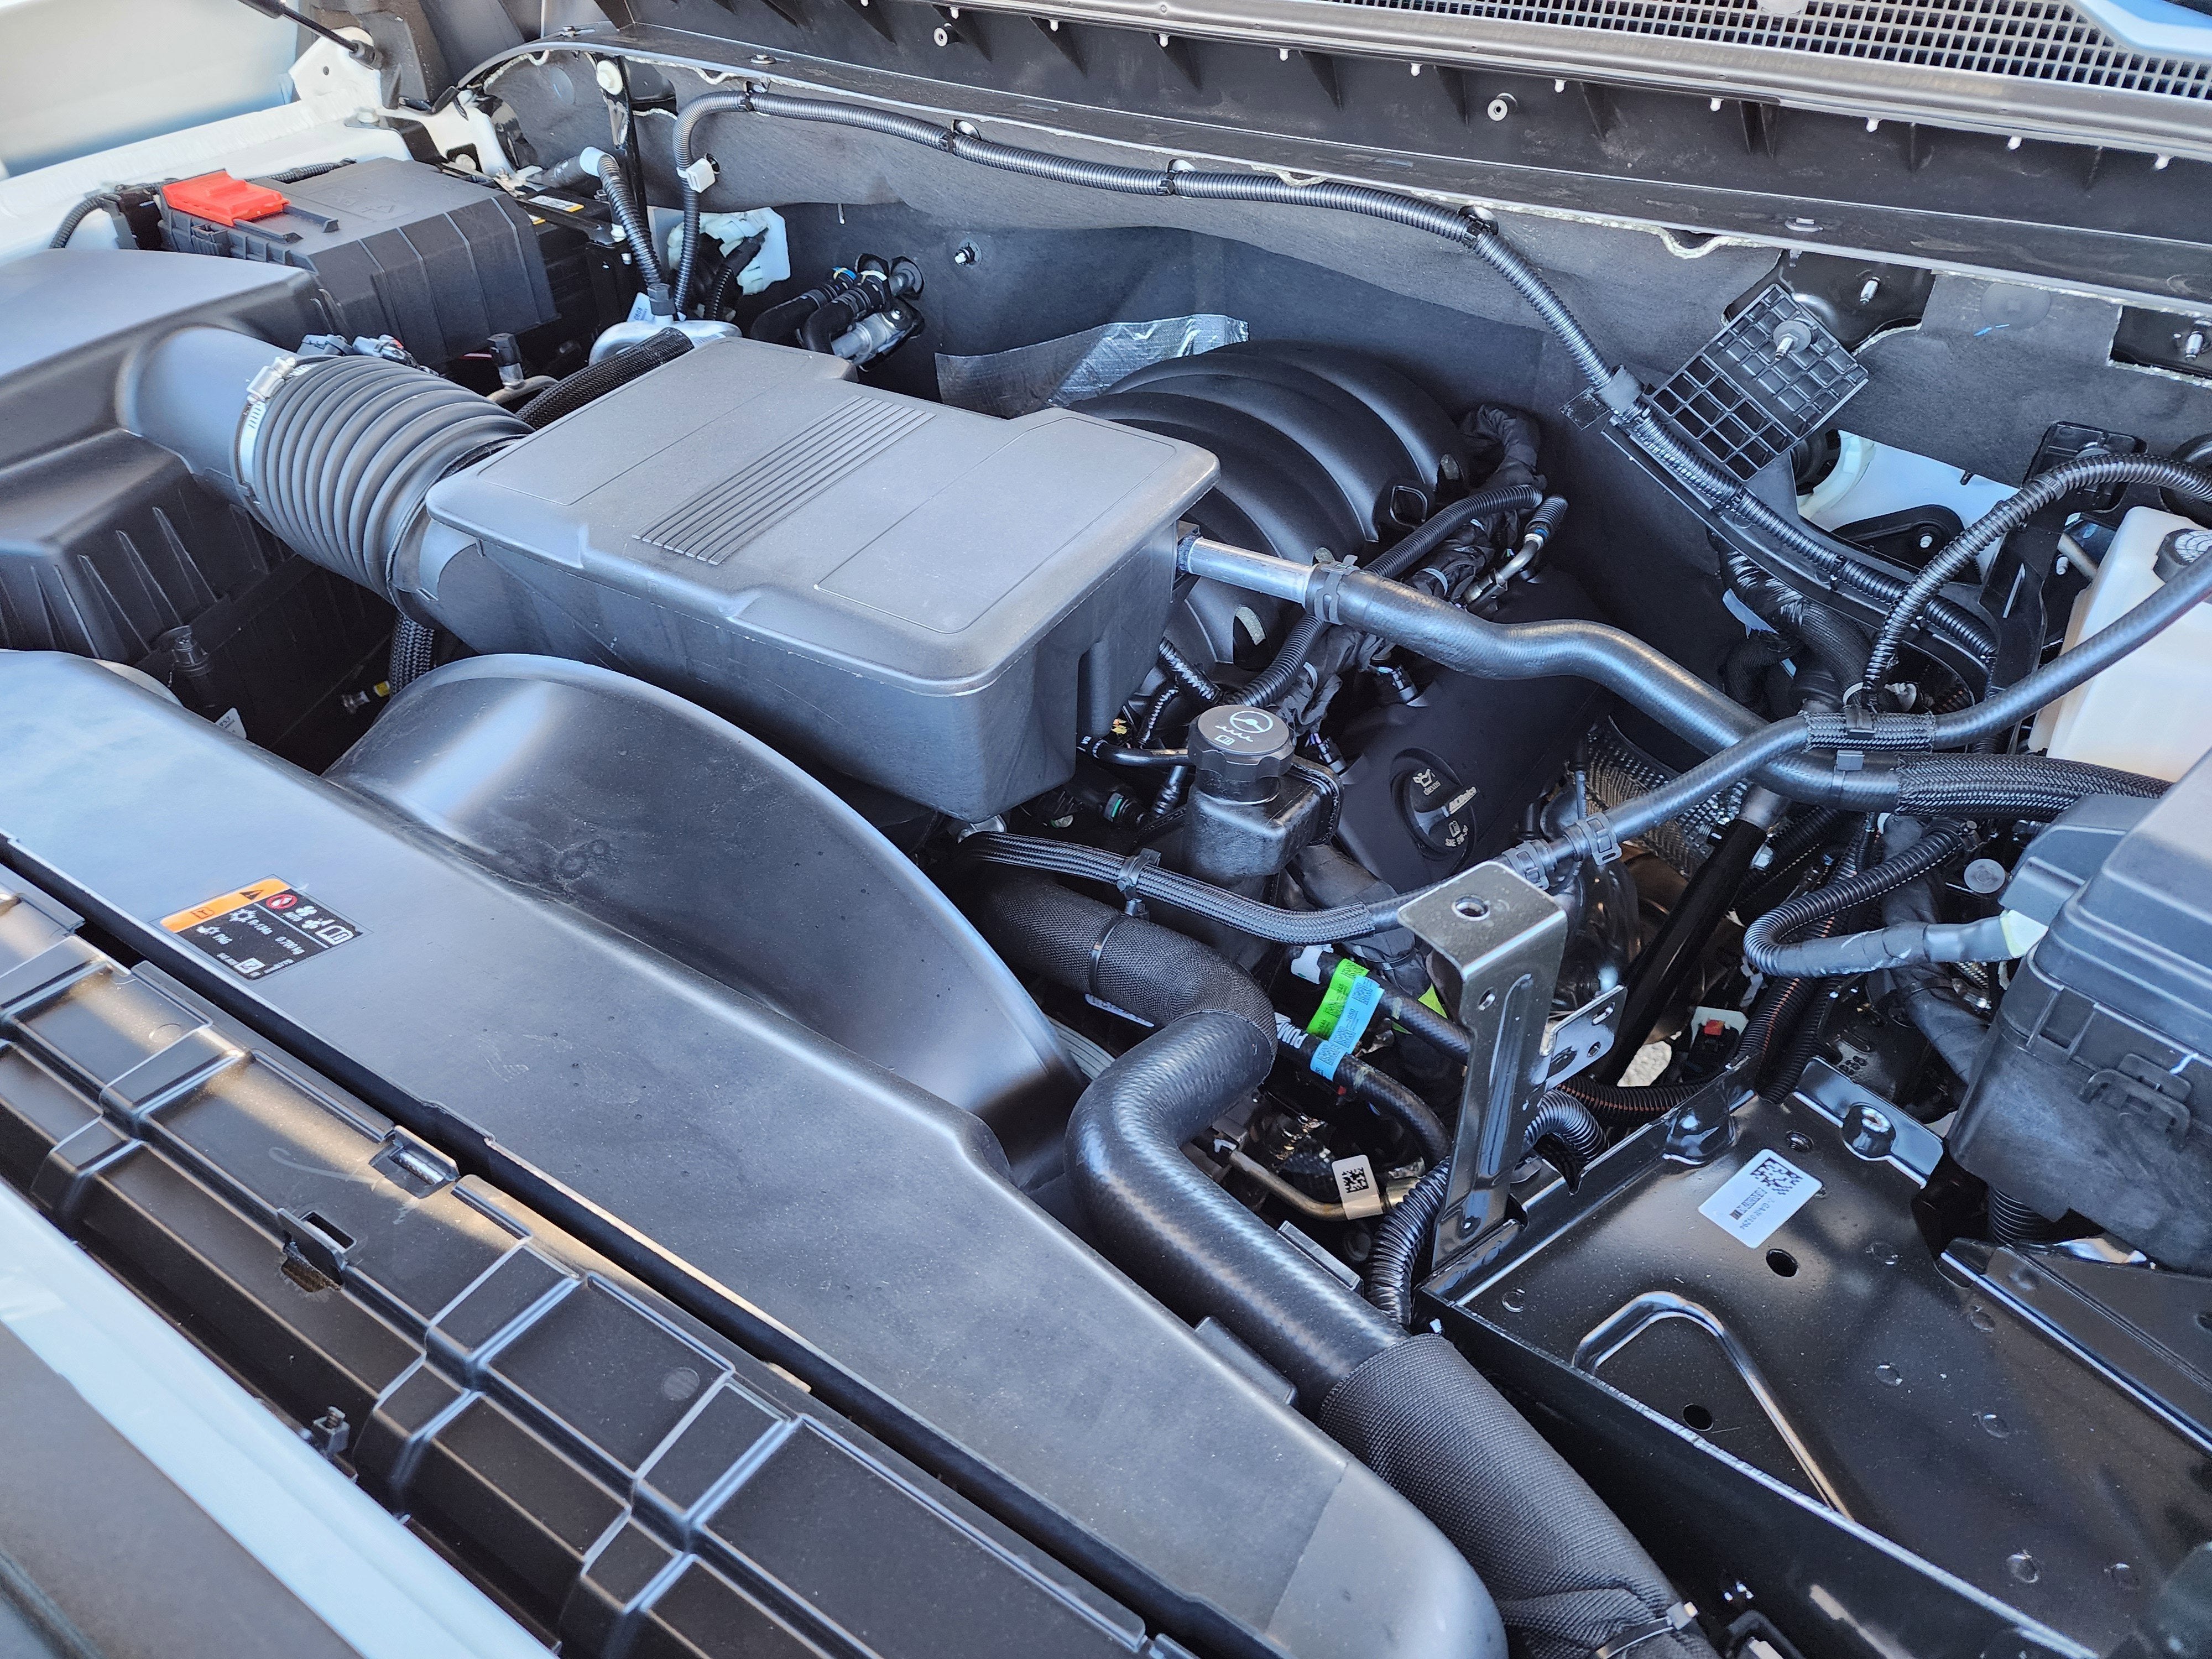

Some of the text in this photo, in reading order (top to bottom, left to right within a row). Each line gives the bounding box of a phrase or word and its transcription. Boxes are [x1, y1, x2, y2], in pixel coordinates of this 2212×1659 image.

[1423, 780, 1441, 796] dexos
[1449, 786, 1477, 815] ACDelco
[283, 912, 304, 922] AUTO
[247, 919, 273, 935] R-134a
[212, 933, 233, 945] PAG
